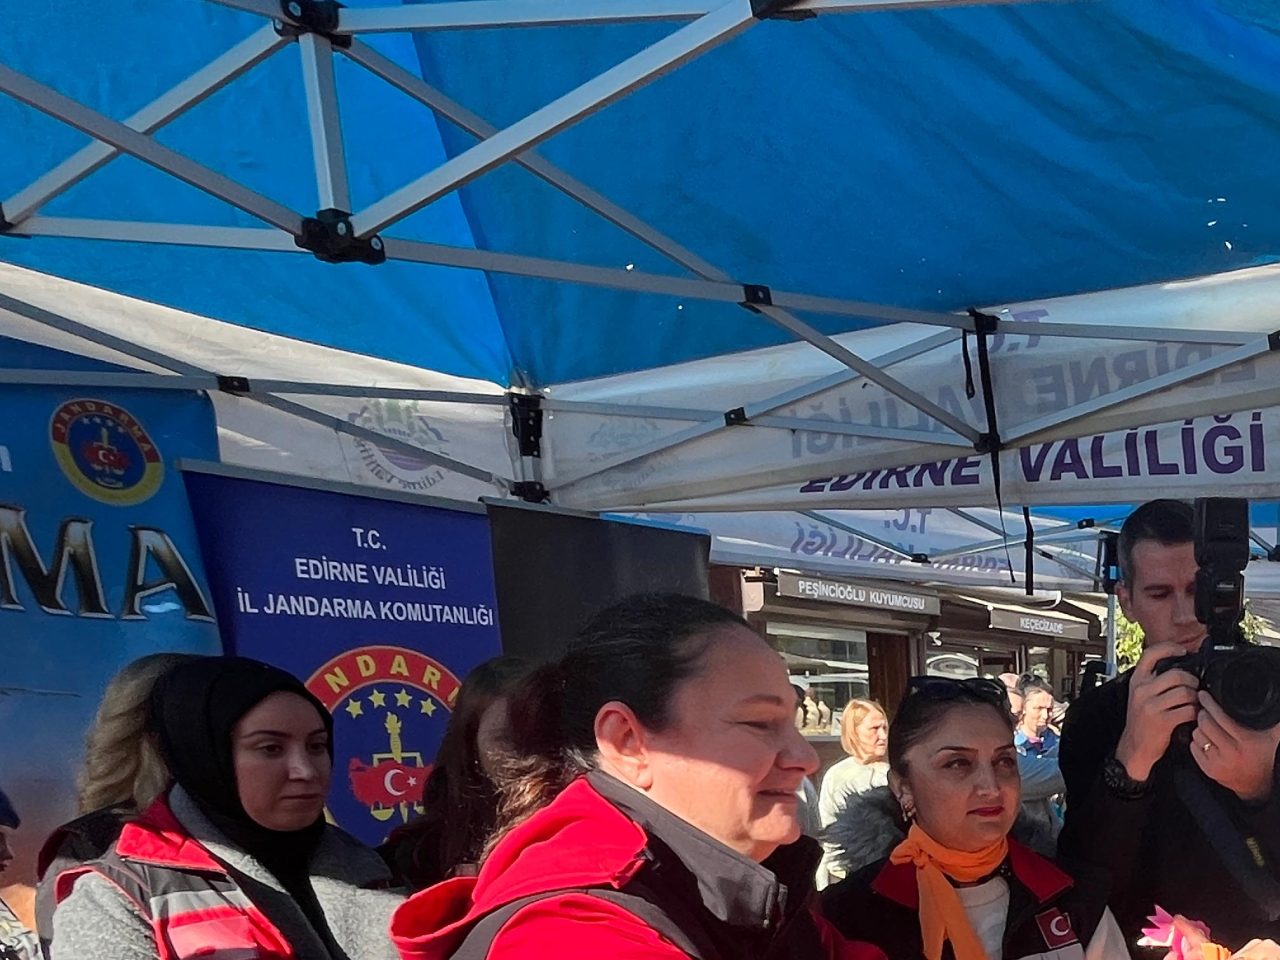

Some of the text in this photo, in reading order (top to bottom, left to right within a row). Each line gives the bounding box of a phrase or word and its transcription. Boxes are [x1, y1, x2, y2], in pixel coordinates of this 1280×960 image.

[56, 399, 156, 453] JANDARMA
[1019, 412, 1266, 484] VALİLİĞİ
[351, 527, 387, 550] T.C.
[294, 555, 446, 590] EDİRNE VALİLİĞİ
[237, 587, 494, 626] İL JANDARMA KOMUTANLIĞI
[869, 591, 926, 611] KUYUMCUSU
[324, 654, 461, 704] NDAR
